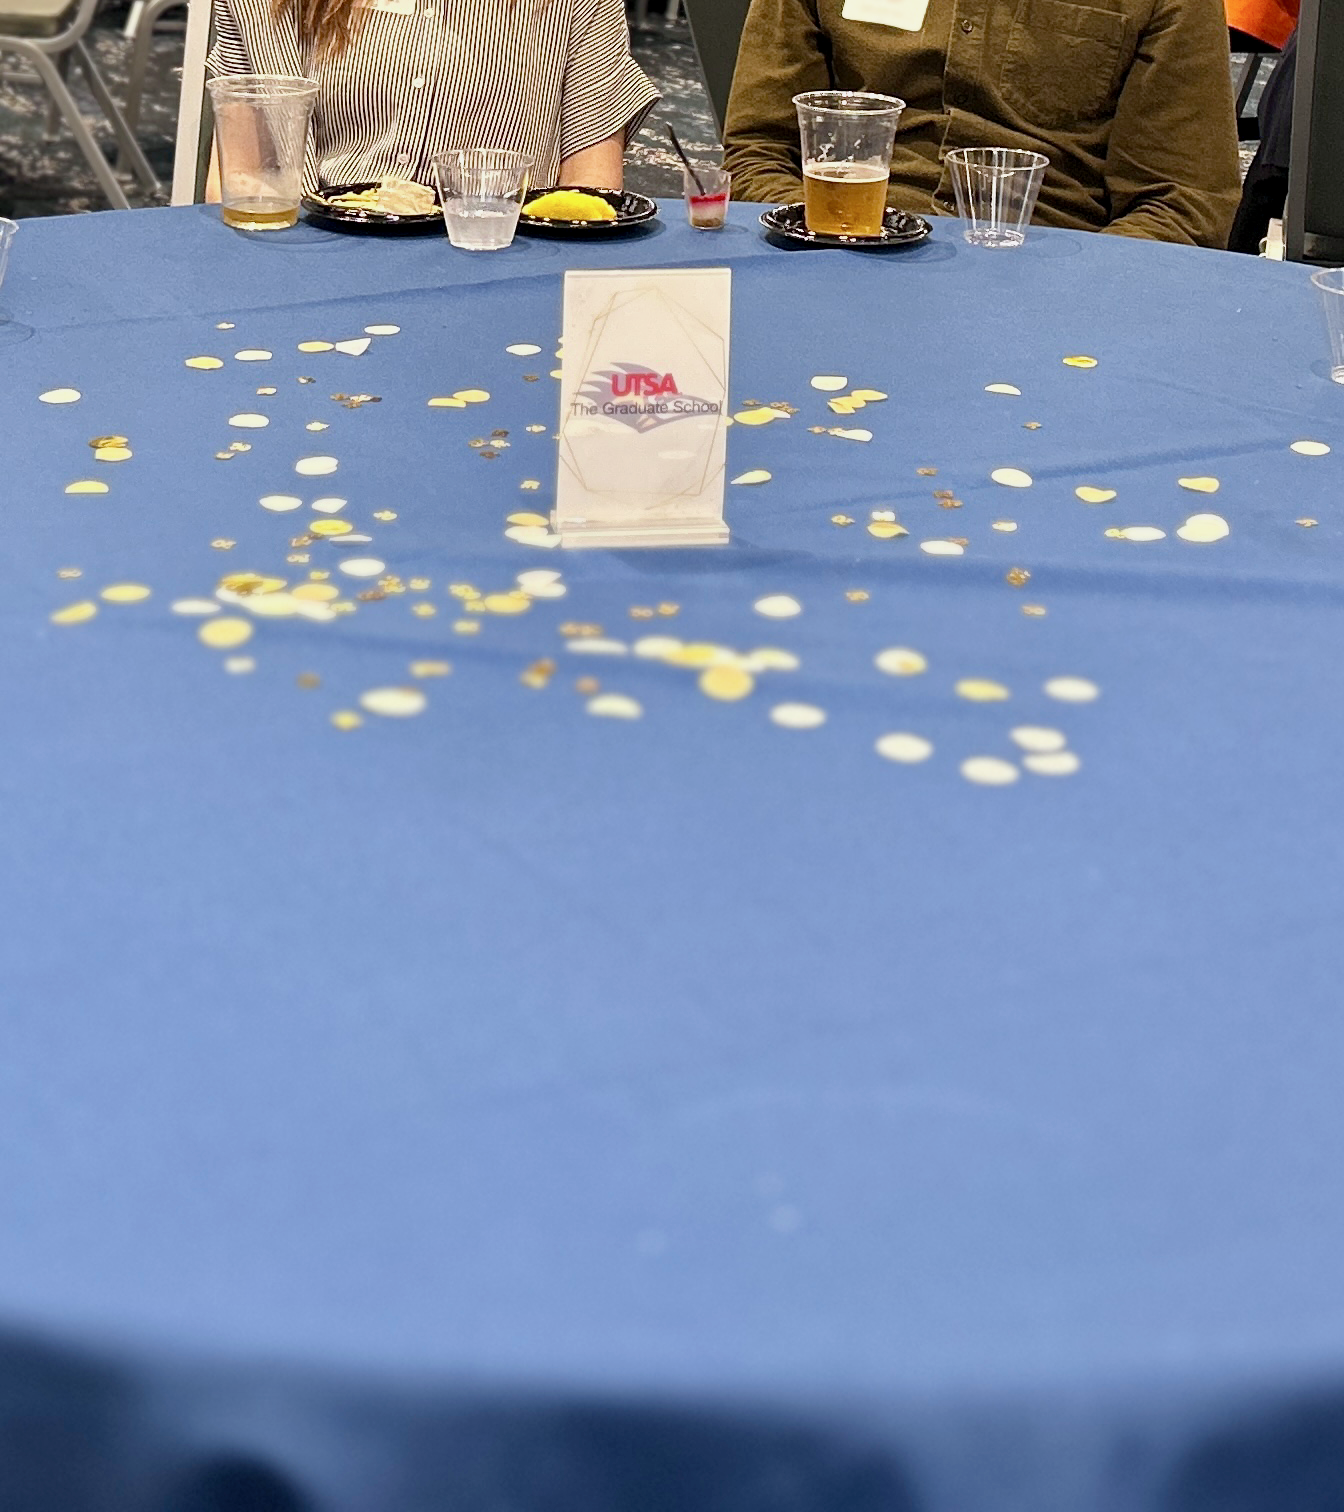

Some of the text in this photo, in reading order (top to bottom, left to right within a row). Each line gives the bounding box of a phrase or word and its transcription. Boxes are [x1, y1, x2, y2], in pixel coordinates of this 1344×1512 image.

[611, 373, 678, 397] UTSA
[571, 399, 723, 416] The Graduate School
